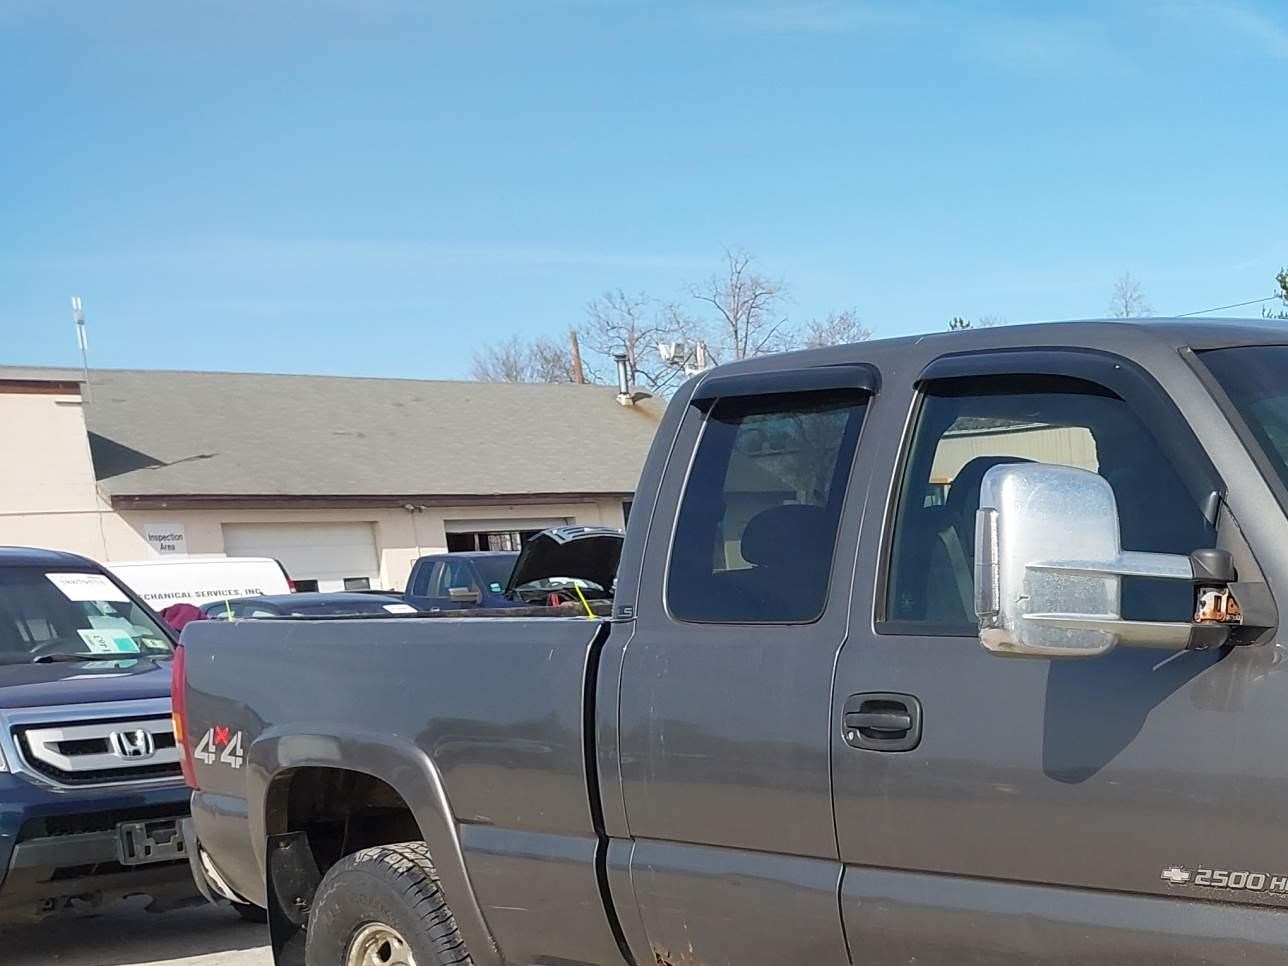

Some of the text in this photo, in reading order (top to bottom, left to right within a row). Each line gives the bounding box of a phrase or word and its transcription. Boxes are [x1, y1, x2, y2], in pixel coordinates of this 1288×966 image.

[148, 533, 184, 542] Inspection
[160, 543, 176, 551] Area
[1194, 869, 1265, 890] 2500
